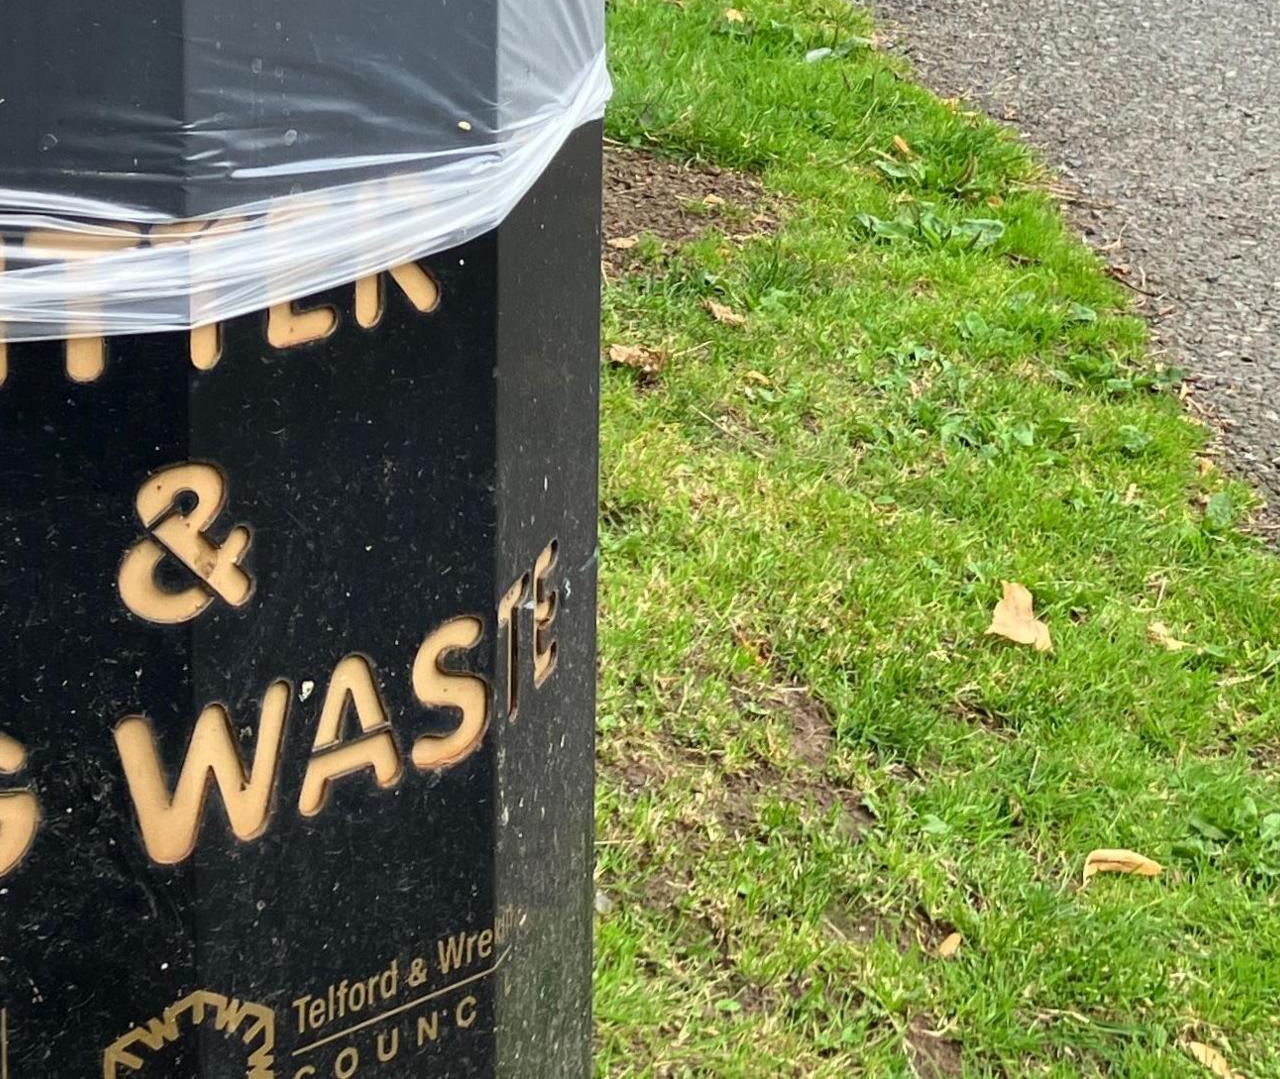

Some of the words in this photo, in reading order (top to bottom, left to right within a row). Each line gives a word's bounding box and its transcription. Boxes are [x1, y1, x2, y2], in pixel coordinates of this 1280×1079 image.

[119, 460, 254, 623] &
[113, 537, 560, 866] WASTE
[292, 959, 400, 1034] Telford
[406, 957, 428, 987] &
